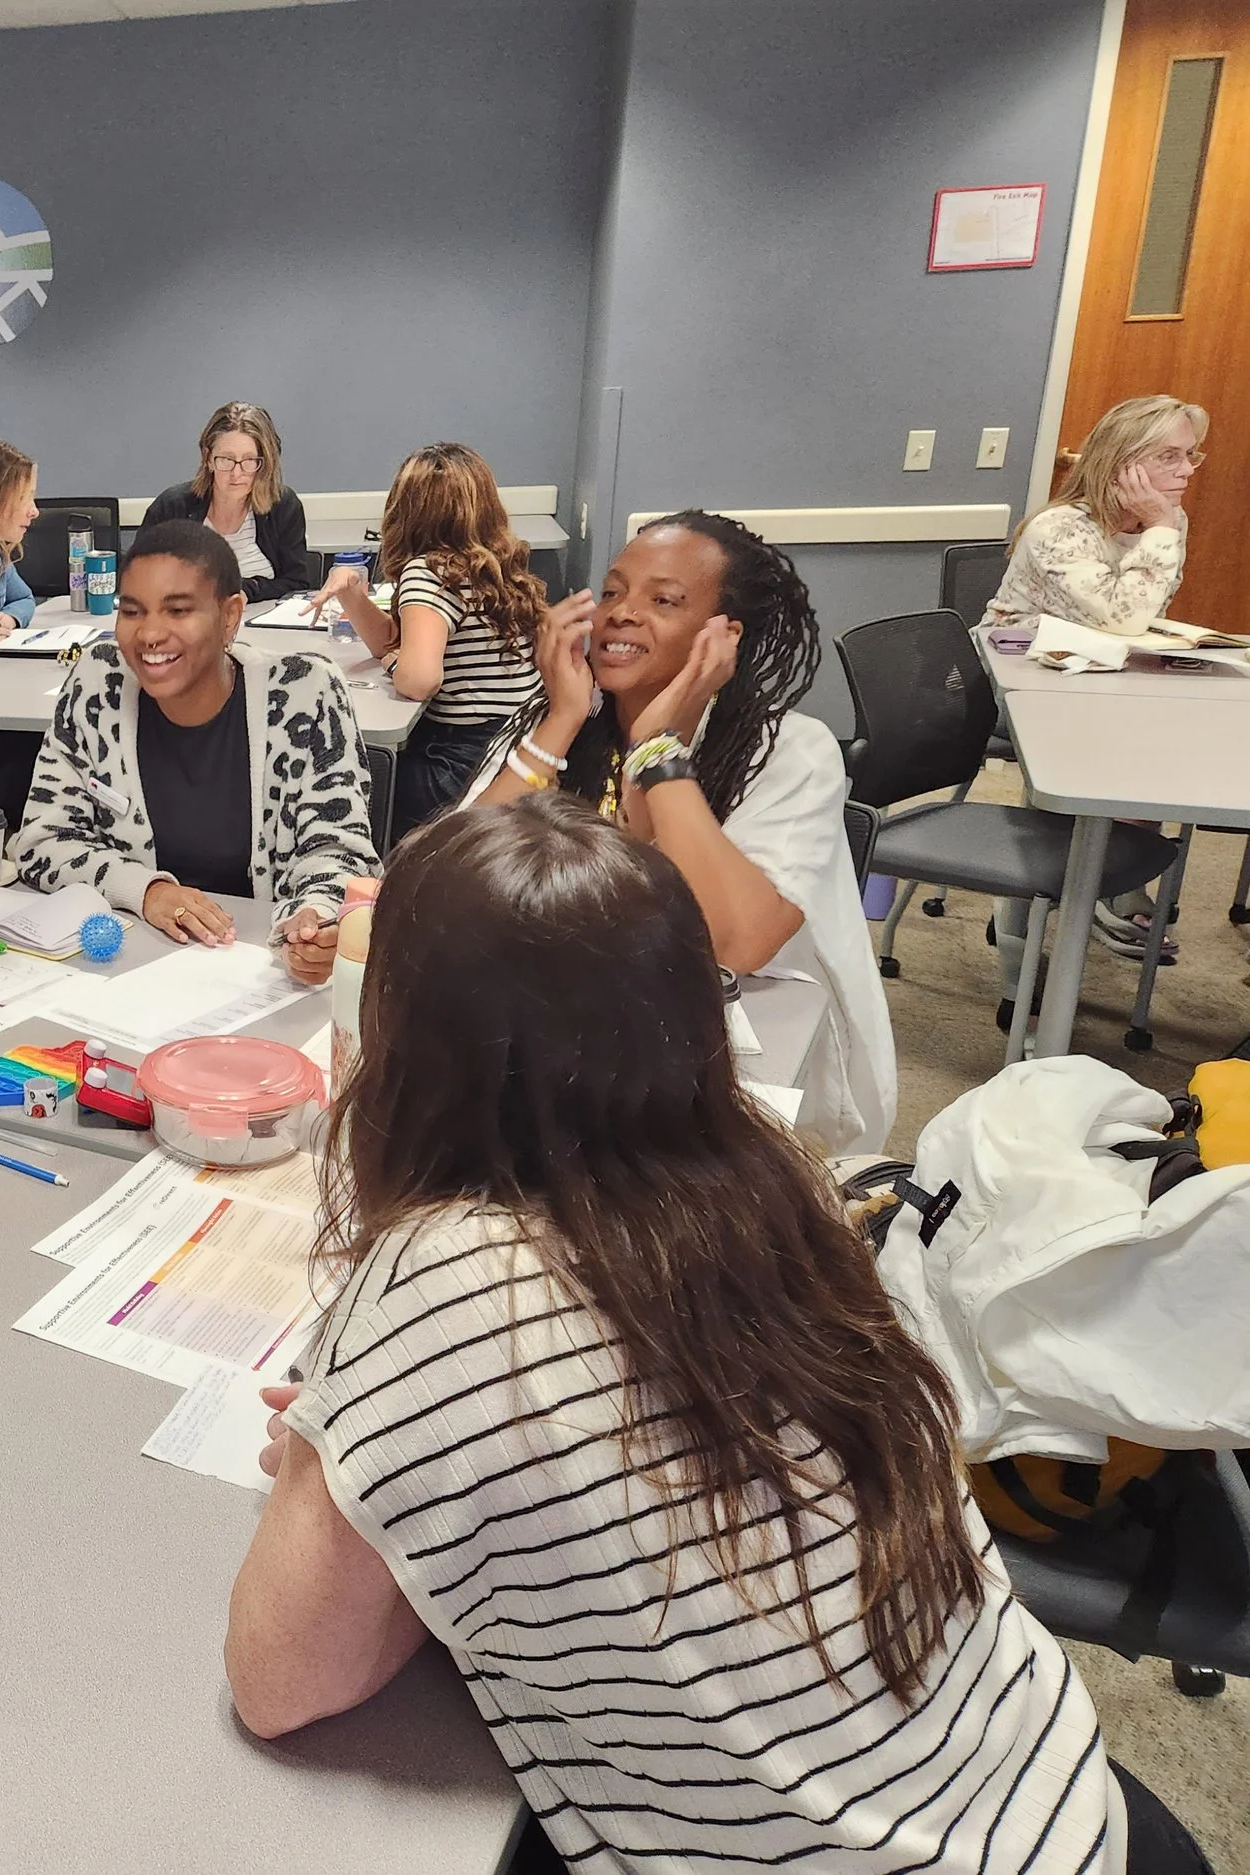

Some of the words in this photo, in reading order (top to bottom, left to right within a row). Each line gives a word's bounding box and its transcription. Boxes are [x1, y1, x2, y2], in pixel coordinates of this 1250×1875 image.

[49, 1233, 82, 1256] Supportive
[80, 1203, 120, 1234] Environments
[116, 1196, 127, 1206] for
[125, 1166, 161, 1198] Effectiveness
[39, 1304, 71, 1331] Supportive
[67, 1273, 105, 1306] Environments
[101, 1265, 111, 1275] for
[109, 1237, 143, 1267] Effectiveness
